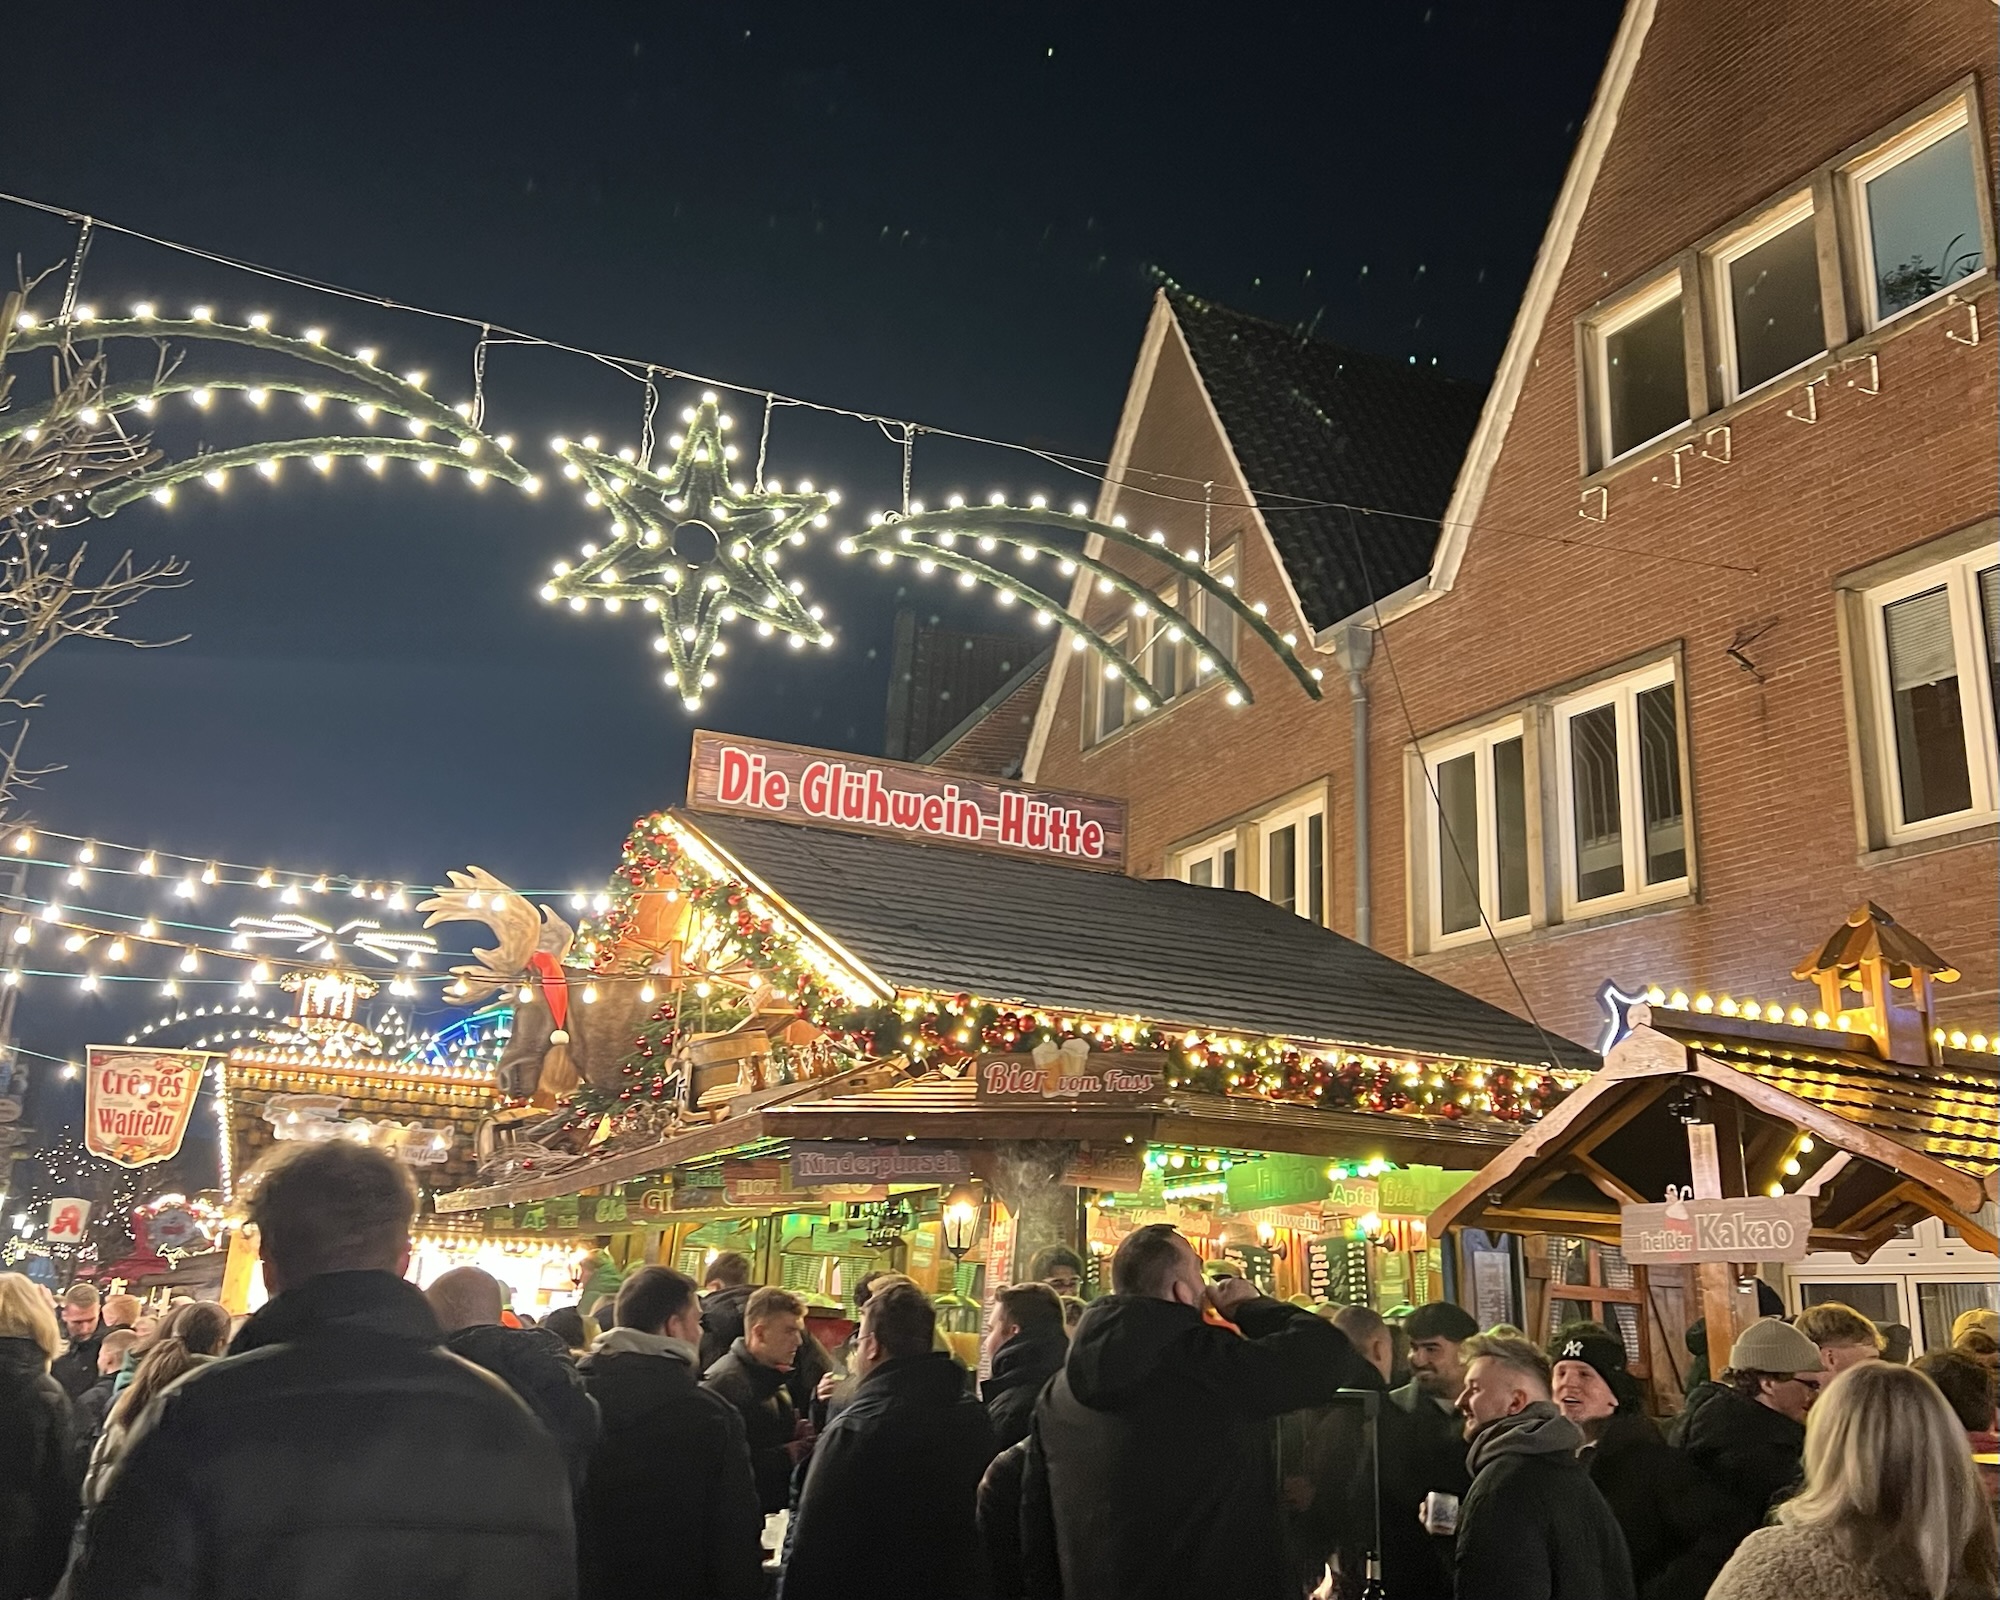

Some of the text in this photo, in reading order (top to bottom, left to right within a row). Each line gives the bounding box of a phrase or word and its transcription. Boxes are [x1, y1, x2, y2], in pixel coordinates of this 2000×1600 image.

[719, 748, 1104, 857] Die Glühwein-Hütte
[984, 1062, 1154, 1094] Bier vom Fass
[98, 1108, 174, 1136] Waffeln
[799, 1150, 962, 1179] Kinderpunsch
[736, 1179, 777, 1196] HOT
[1640, 1213, 1794, 1252] heißer Kakao
